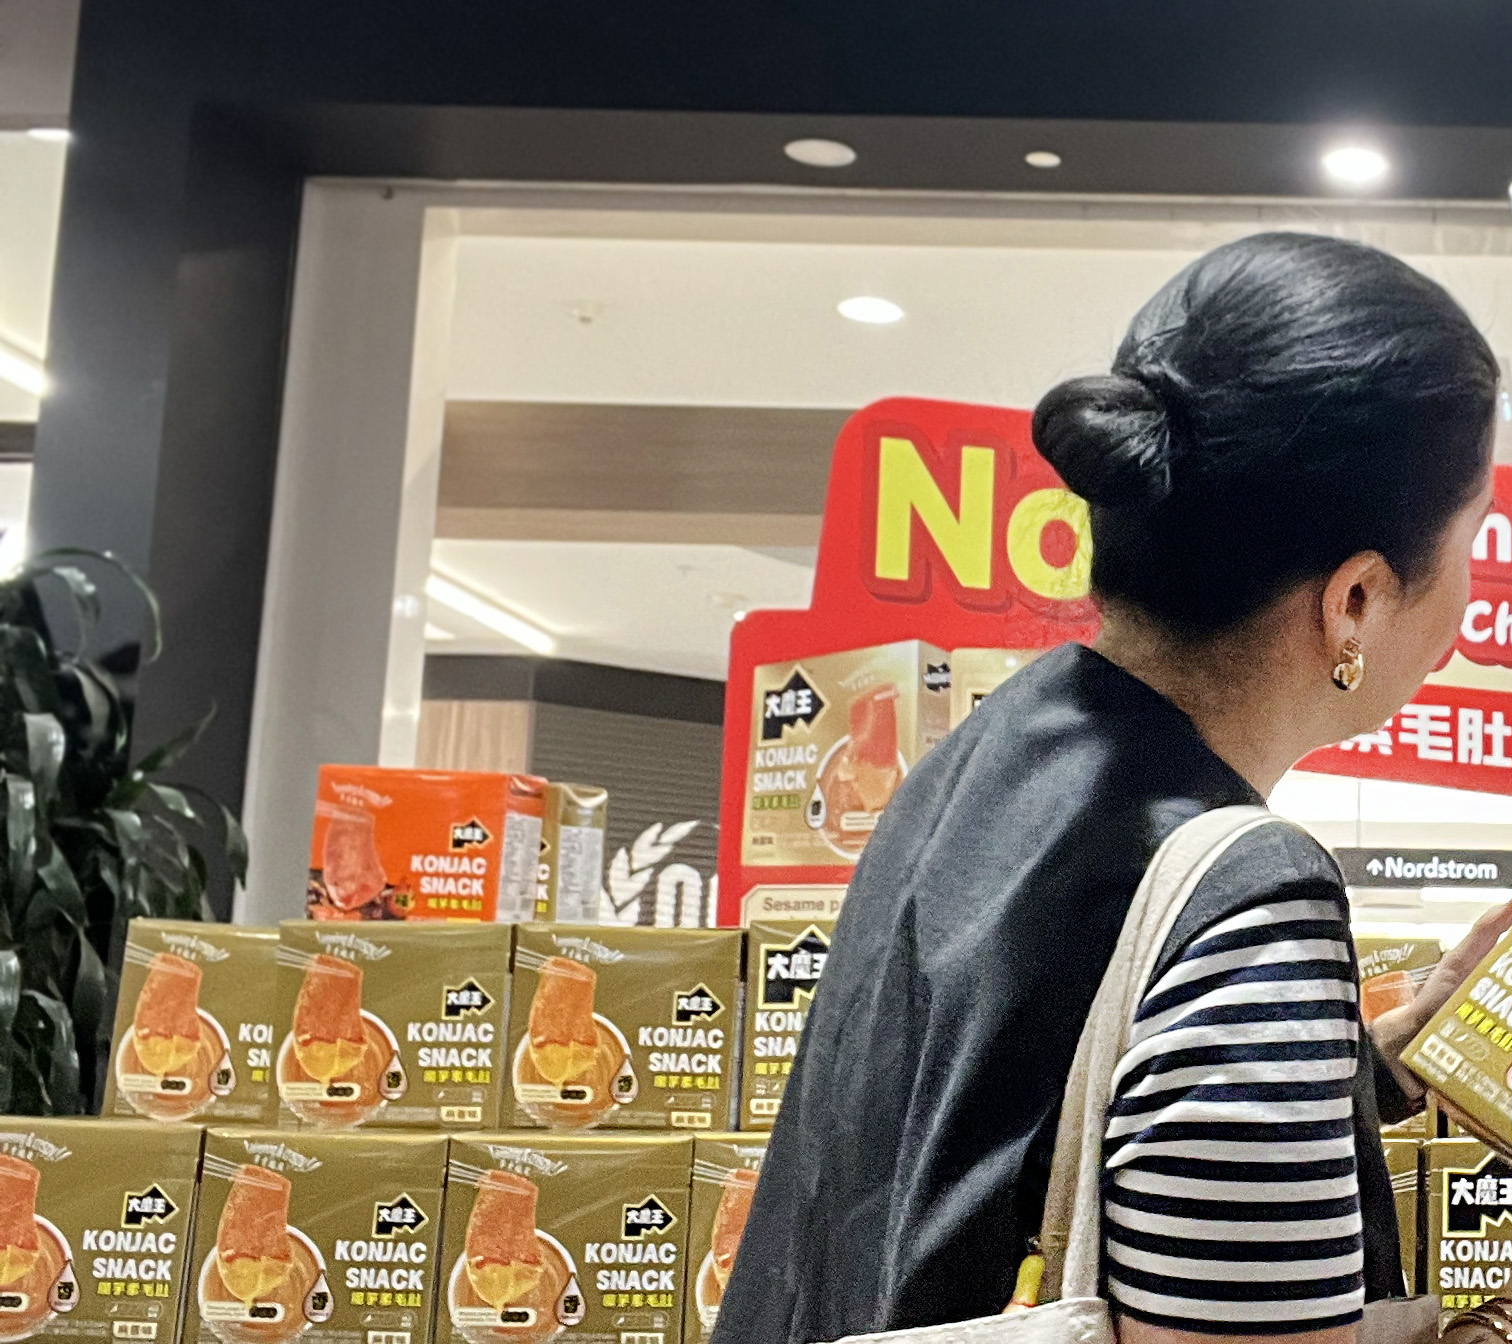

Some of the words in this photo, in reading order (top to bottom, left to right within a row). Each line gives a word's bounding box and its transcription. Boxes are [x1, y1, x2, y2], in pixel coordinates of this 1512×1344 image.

[411, 855, 486, 874] KONJAC
[1385, 858, 1497, 880] Nordstrom
[421, 877, 483, 895] SNACK
[408, 1023, 494, 1042] KONJAC
[639, 1027, 724, 1048] KONJAC
[418, 1048, 492, 1067] SNACK
[649, 1053, 721, 1073] SNACK
[83, 1230, 176, 1253] KONJAC
[335, 1240, 426, 1263] KONJAC
[585, 1243, 677, 1263] KONJAC
[93, 1258, 171, 1280] SNACK
[346, 1268, 424, 1290] SNACK
[597, 1270, 674, 1290] SNACK
